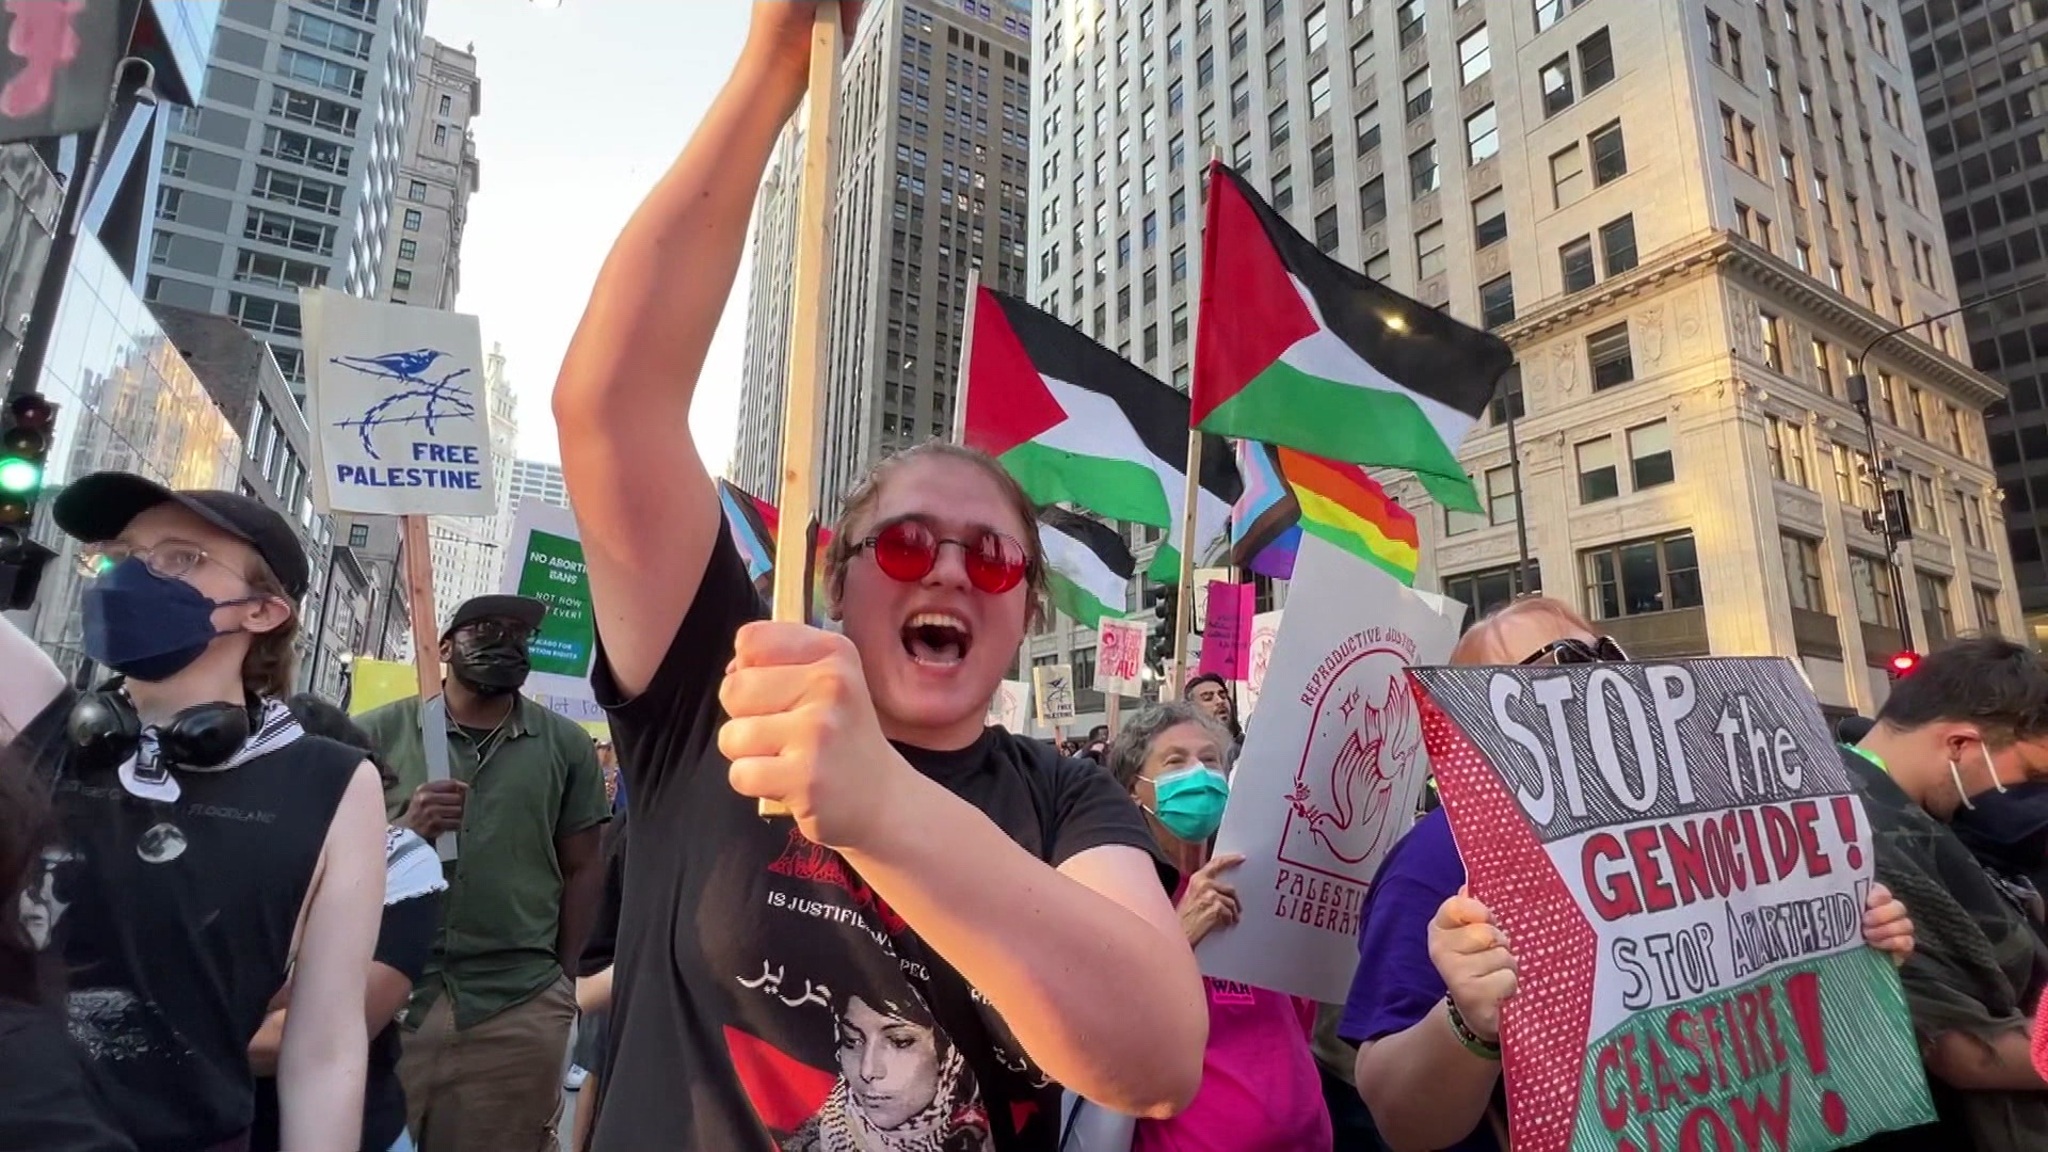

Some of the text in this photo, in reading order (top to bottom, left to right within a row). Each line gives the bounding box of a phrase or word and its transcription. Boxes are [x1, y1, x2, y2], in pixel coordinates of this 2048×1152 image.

[412, 442, 480, 464] FREE
[337, 464, 482, 489] PALESTINE
[529, 551, 547, 563] NO
[548, 569, 579, 585] BANS
[558, 596, 582, 608] NOW
[1300, 626, 1382, 707] REPRODUCTIVE
[1488, 664, 1803, 826] STOP the
[767, 891, 786, 907] IS
[1275, 868, 1365, 912] PALESTI
[1611, 922, 1720, 1011] STOP
